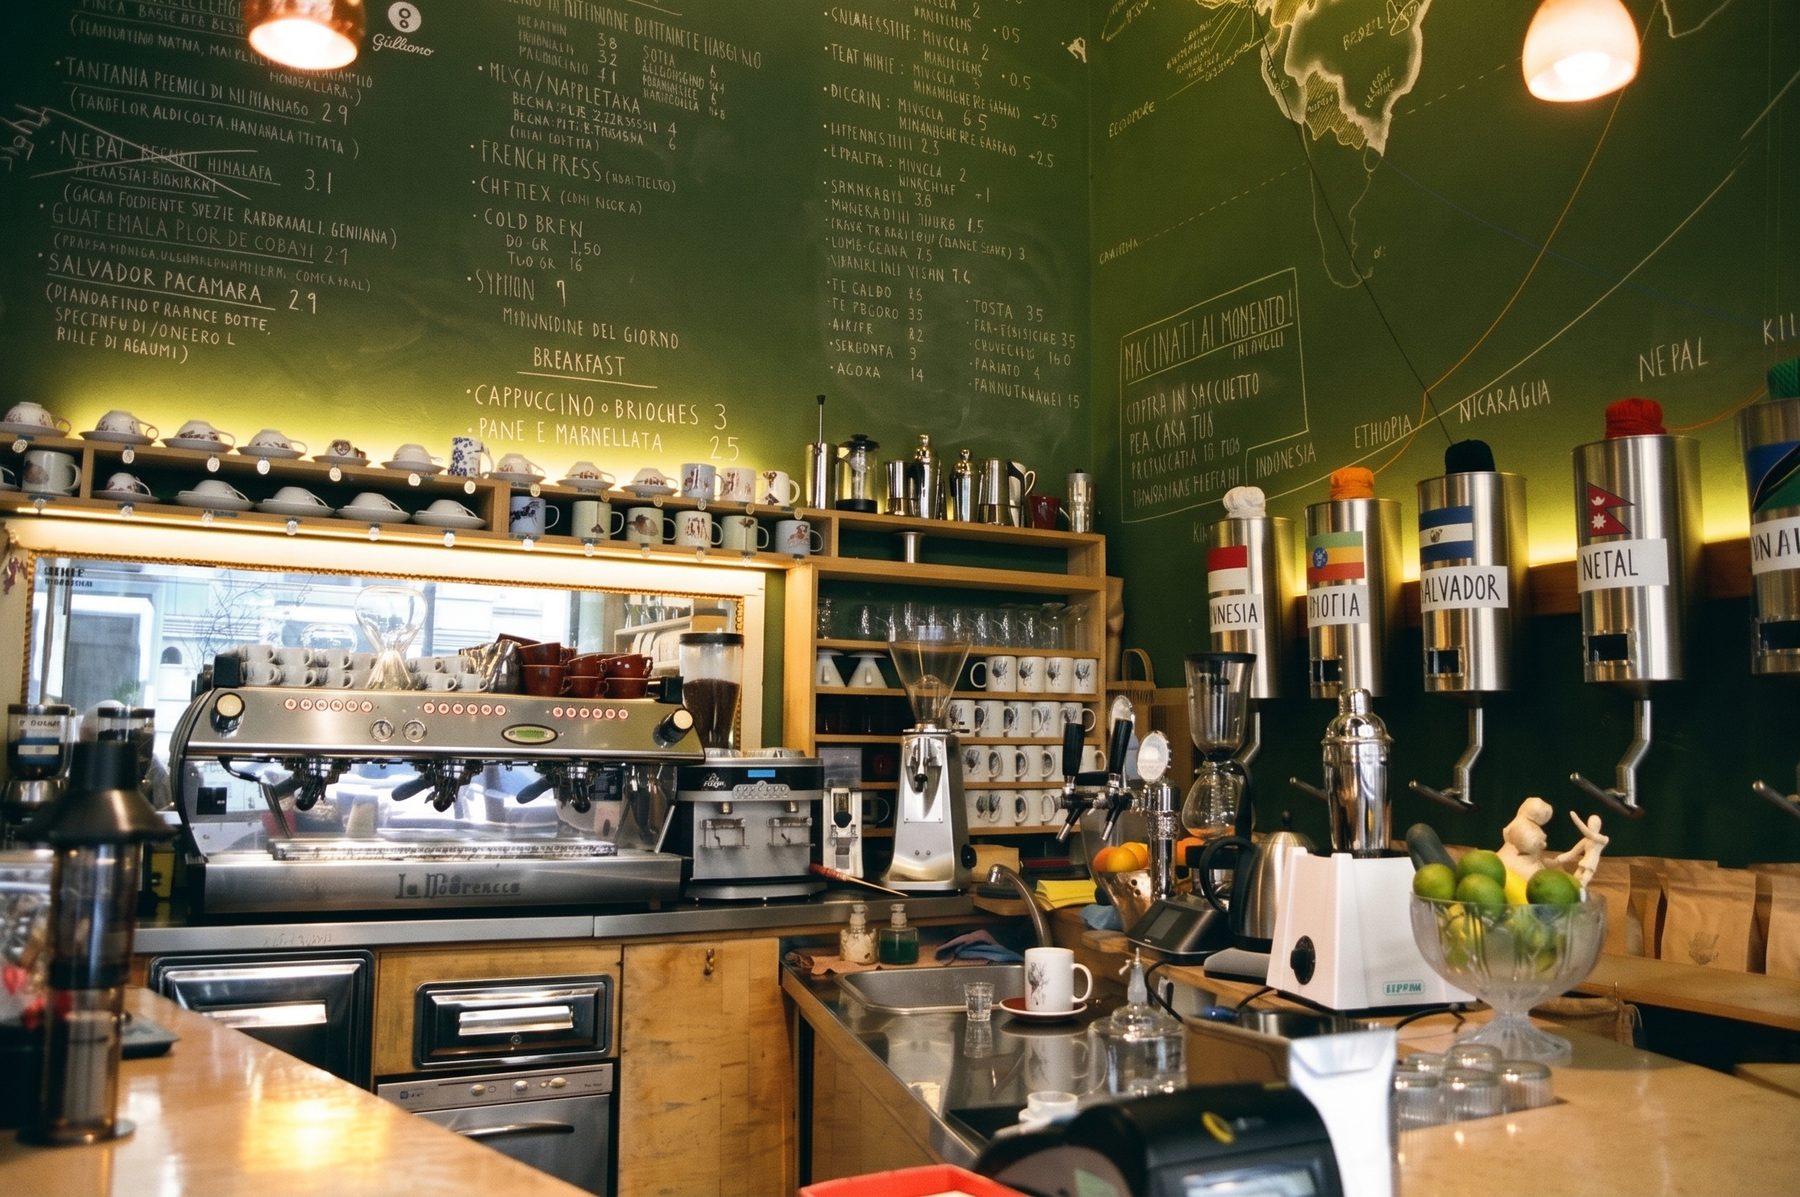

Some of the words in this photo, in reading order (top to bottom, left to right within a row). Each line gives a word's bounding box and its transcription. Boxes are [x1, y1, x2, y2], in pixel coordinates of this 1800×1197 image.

[482, 139, 546, 171] FRENCH
[552, 153, 602, 182] PRESS
[484, 208, 528, 231] COLD
[227, 229, 249, 248] DE
[48, 252, 156, 286] SALVADOR
[164, 270, 262, 304] PACAMARA
[973, 299, 1014, 320] TOSTA
[593, 322, 617, 340] DEL
[624, 326, 680, 350] GIORNO
[534, 346, 626, 377] BREAKFAST
[1639, 336, 1709, 383] NEPAL
[474, 383, 594, 418] CAPPUCCINO
[615, 397, 700, 426] BRIOCHES
[713, 403, 728, 431] 3
[479, 417, 525, 442] PANE
[537, 421, 546, 443] E
[1354, 414, 1413, 449] ETHIOPIA
[1255, 442, 1317, 480] INDONESIA
